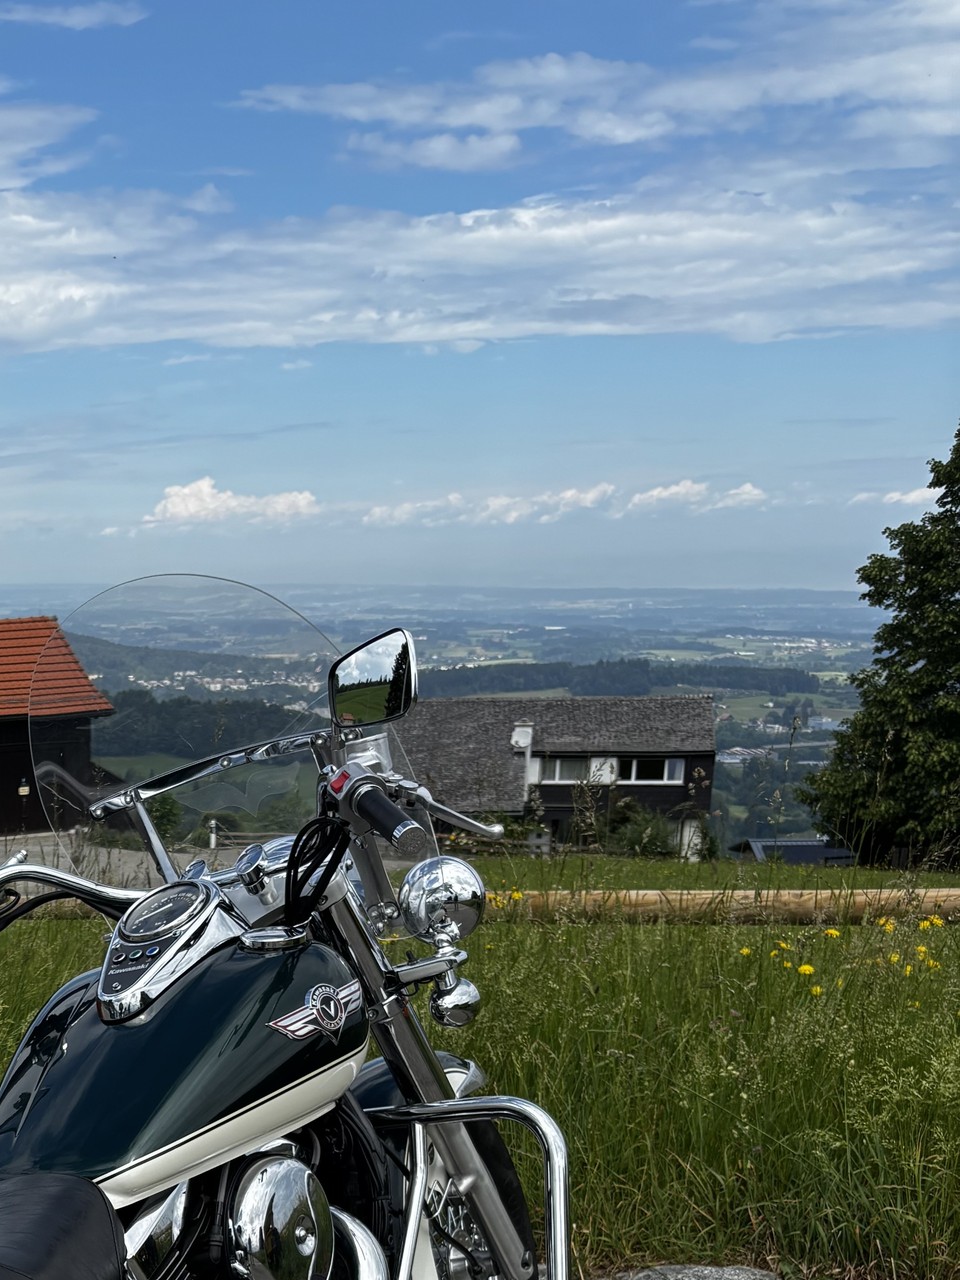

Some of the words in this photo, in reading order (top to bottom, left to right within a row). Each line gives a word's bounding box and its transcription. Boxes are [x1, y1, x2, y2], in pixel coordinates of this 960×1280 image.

[108, 962, 150, 975] Kawasaki
[311, 986, 338, 1006] Kawasaki
[321, 1000, 335, 1017] V
